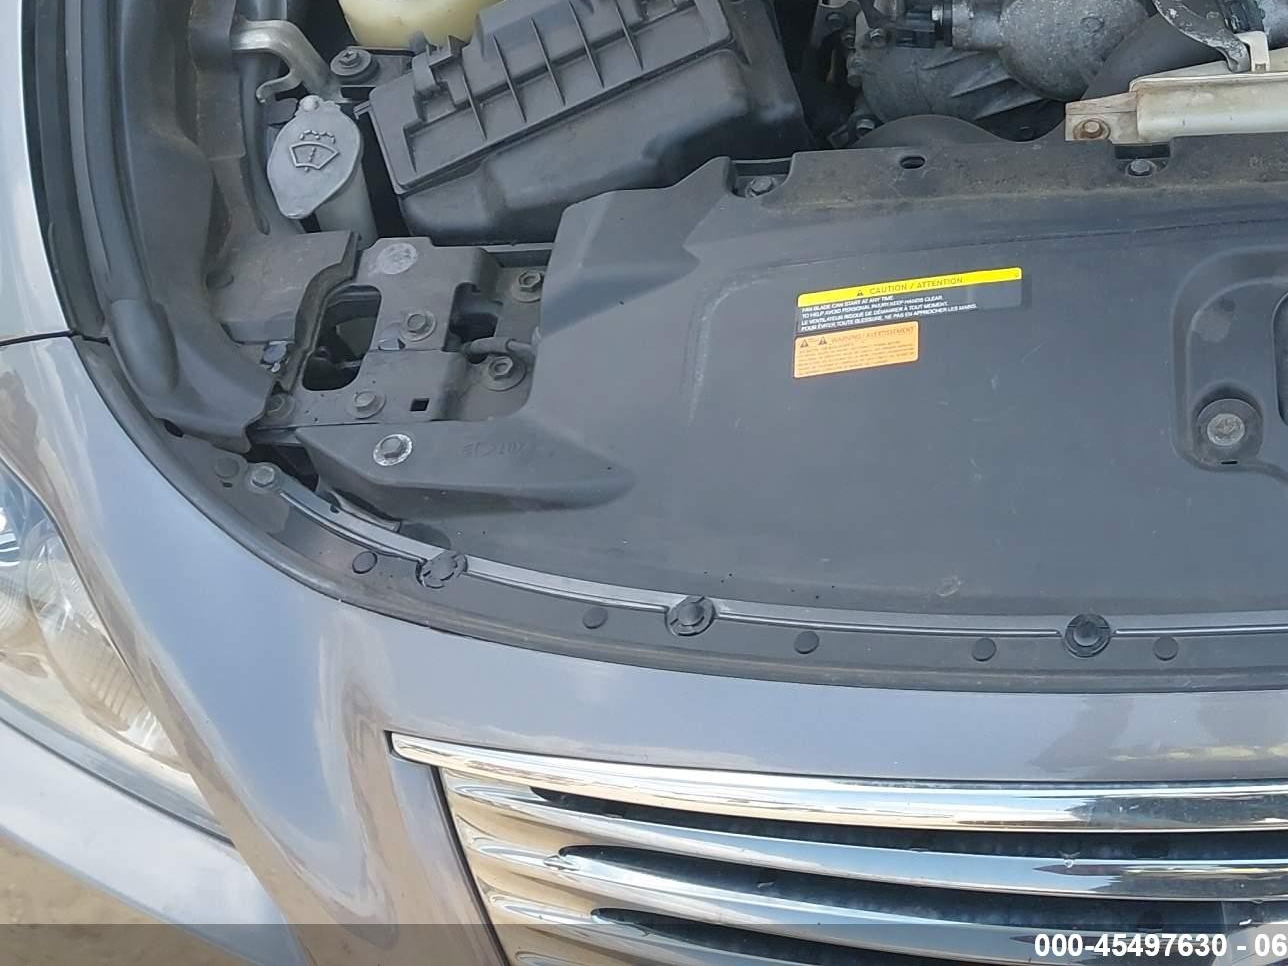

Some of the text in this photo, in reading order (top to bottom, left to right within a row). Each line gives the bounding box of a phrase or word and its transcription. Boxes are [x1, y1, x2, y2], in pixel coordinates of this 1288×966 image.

[869, 283, 907, 295] CAUTION
[917, 277, 963, 289] ATTENTION
[913, 307, 947, 316] APPROCHER
[809, 314, 843, 324] VENTILATEUR
